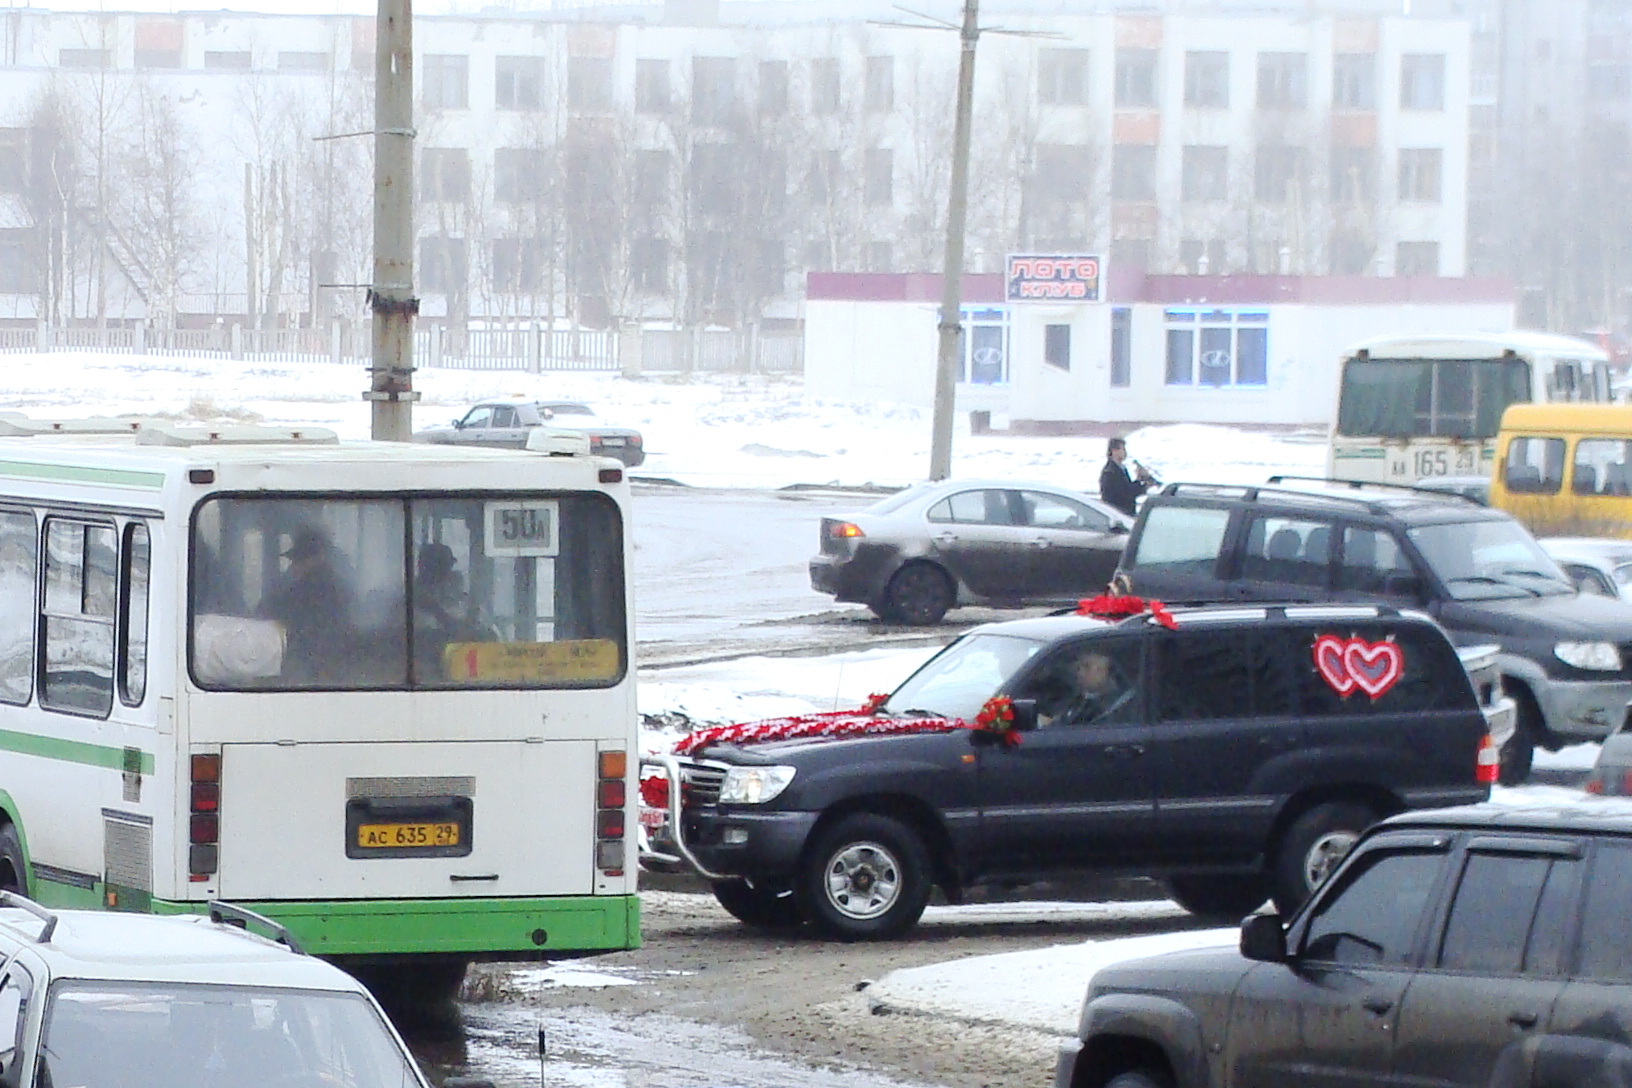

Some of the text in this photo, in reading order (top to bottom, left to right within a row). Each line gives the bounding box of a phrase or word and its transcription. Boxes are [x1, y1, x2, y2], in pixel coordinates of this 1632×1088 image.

[1011, 259, 1098, 279] ЛОТО
[1020, 281, 1086, 298] КЛУБ
[1414, 450, 1449, 477] 165
[465, 649, 478, 678] 1
[368, 825, 453, 844] АС 635 29
